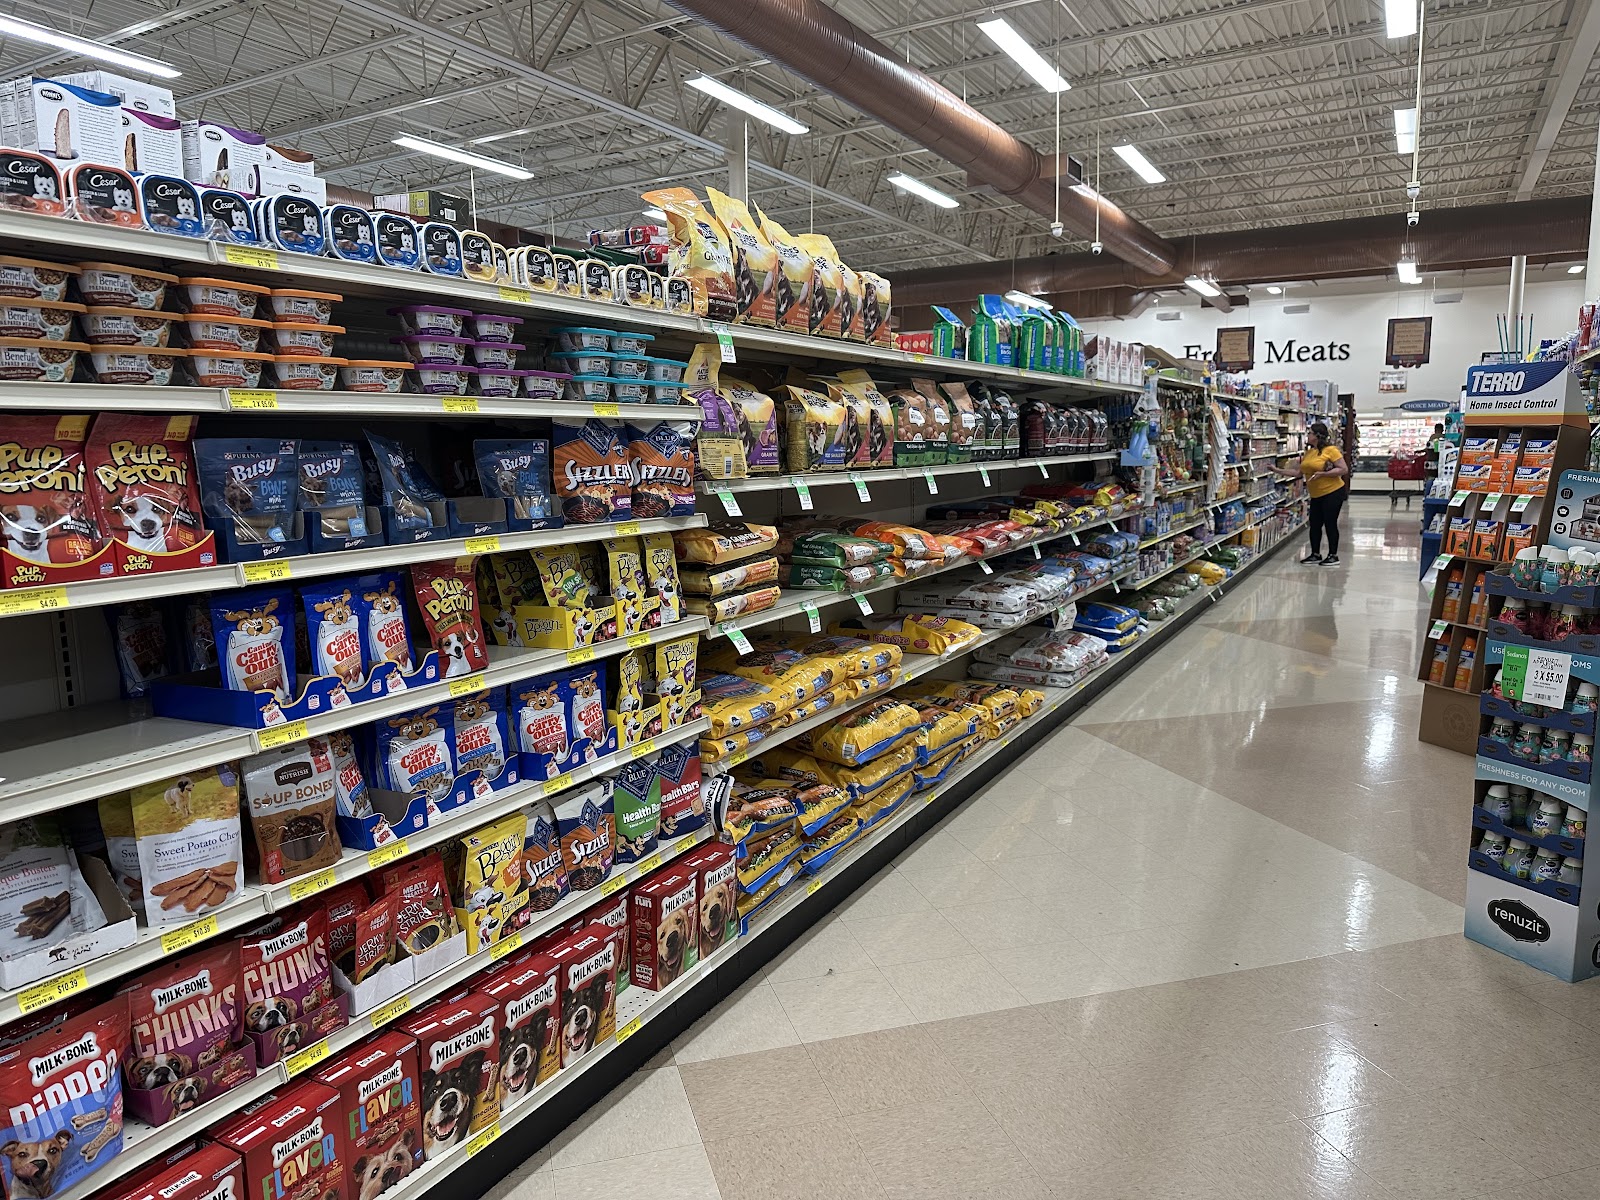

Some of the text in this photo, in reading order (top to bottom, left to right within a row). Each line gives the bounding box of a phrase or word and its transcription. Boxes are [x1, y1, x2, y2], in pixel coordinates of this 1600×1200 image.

[8, 160, 40, 174] Cesar
[90, 175, 119, 188] Cesar
[156, 184, 183, 197] Cesar
[212, 199, 236, 210] Cesar
[286, 203, 308, 215] Cesar
[341, 213, 362, 224] Cesar
[386, 222, 405, 233] Cesar
[432, 231, 450, 241] Cesar
[1264, 339, 1350, 364] Meats
[1471, 370, 1526, 393] TERRO
[1469, 398, 1558, 410] Home Insect Control
[58, 430, 69, 438] NO
[167, 431, 177, 439] NO
[231, 457, 277, 482] Busy
[303, 458, 342, 478] Busy
[500, 455, 532, 471] Busy
[95, 461, 188, 493] Peroni
[519, 470, 539, 484] BONE
[1516, 467, 1533, 475] TERRO
[260, 480, 287, 496] BONE
[329, 477, 360, 491] BONE
[122, 560, 154, 573] Peroni
[11, 572, 47, 586] Peroni
[39, 598, 58, 608] $4.99
[424, 590, 474, 621] Peroni
[335, 629, 351, 641] Canine
[247, 640, 272, 655] Canine
[326, 631, 357, 656] Carry
[236, 643, 278, 668] Carry
[1533, 670, 1564, 684] 3 X $5.00
[526, 714, 563, 737] Carry
[533, 712, 552, 725] Canine
[455, 726, 491, 750] Carry
[461, 723, 483, 738] Canine
[400, 743, 438, 769] Carry
[408, 742, 431, 756] Canine
[659, 753, 679, 767] BLUE
[279, 769, 309, 781] NUTRISH
[628, 769, 647, 783] BLUE
[1477, 762, 1586, 798] FRESHNESS FOR ANY ROOM
[295, 779, 333, 800] BONES
[661, 787, 682, 804] ealth
[681, 780, 699, 792] Bars
[622, 805, 651, 824] Health
[154, 837, 218, 858] Sweet Potato
[21, 865, 56, 877] Busters
[402, 880, 428, 895] MEATY
[397, 900, 423, 925] JERKY
[1494, 906, 1543, 935] renuzit
[193, 925, 211, 938] $10.39
[358, 931, 385, 958] JERKY
[358, 942, 385, 967] STRIPS
[243, 937, 329, 1003] CHUNKS
[57, 979, 78, 995] $10.39
[133, 984, 238, 1059] CHUNKS
[473, 1101, 500, 1121] medium
